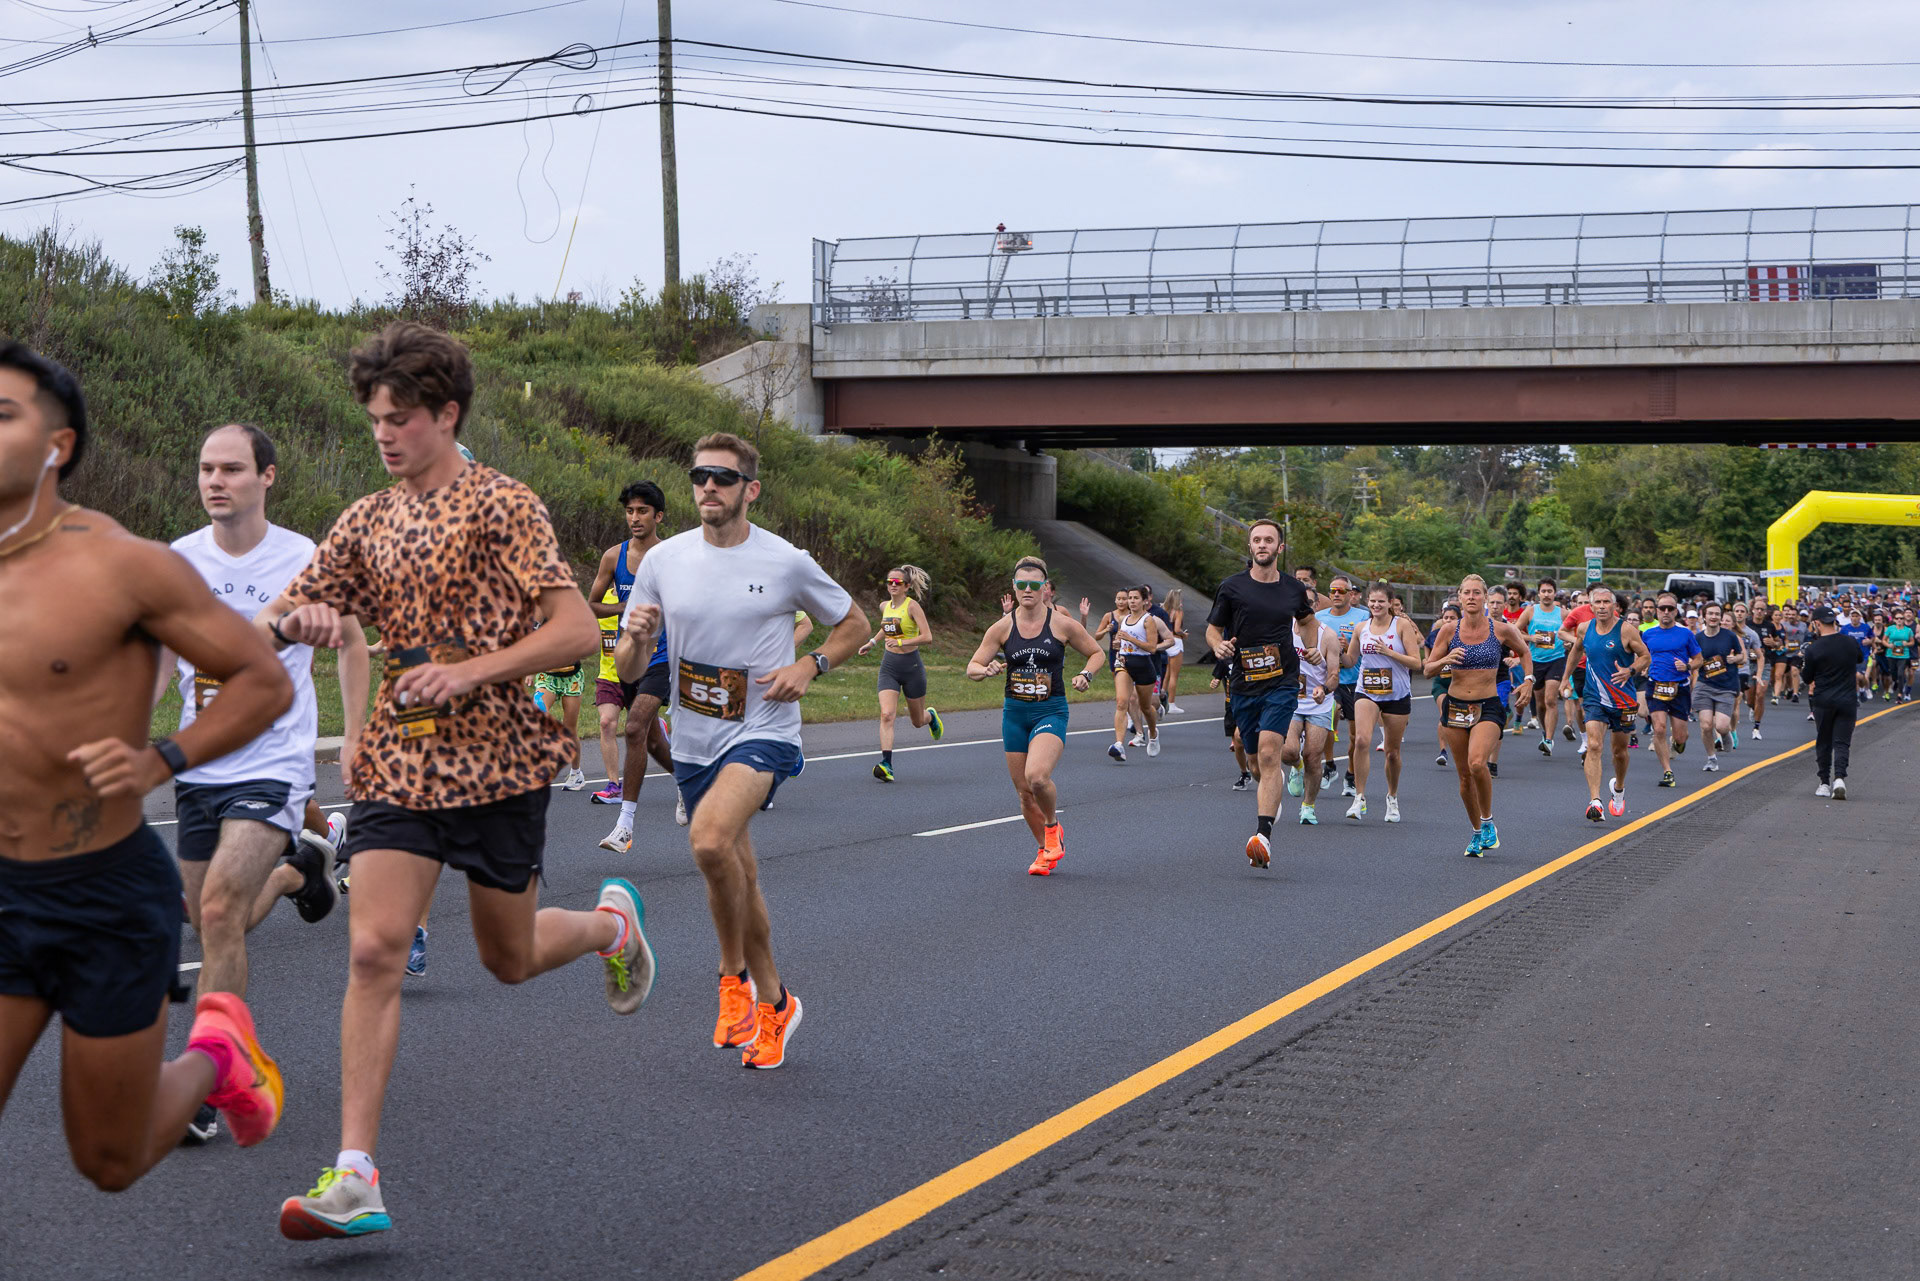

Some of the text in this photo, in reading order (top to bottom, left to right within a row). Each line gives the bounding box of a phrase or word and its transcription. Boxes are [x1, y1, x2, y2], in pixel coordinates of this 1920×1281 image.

[1362, 643, 1394, 651] LEOA
[1011, 647, 1051, 660] PRINCETON
[679, 661, 694, 671] THE
[1246, 655, 1276, 669] 132
[679, 669, 705, 681] CHASE
[1364, 676, 1390, 685] 236
[690, 682, 730, 705] 53
[1013, 683, 1048, 695] 332
[1455, 712, 1475, 722] 24
